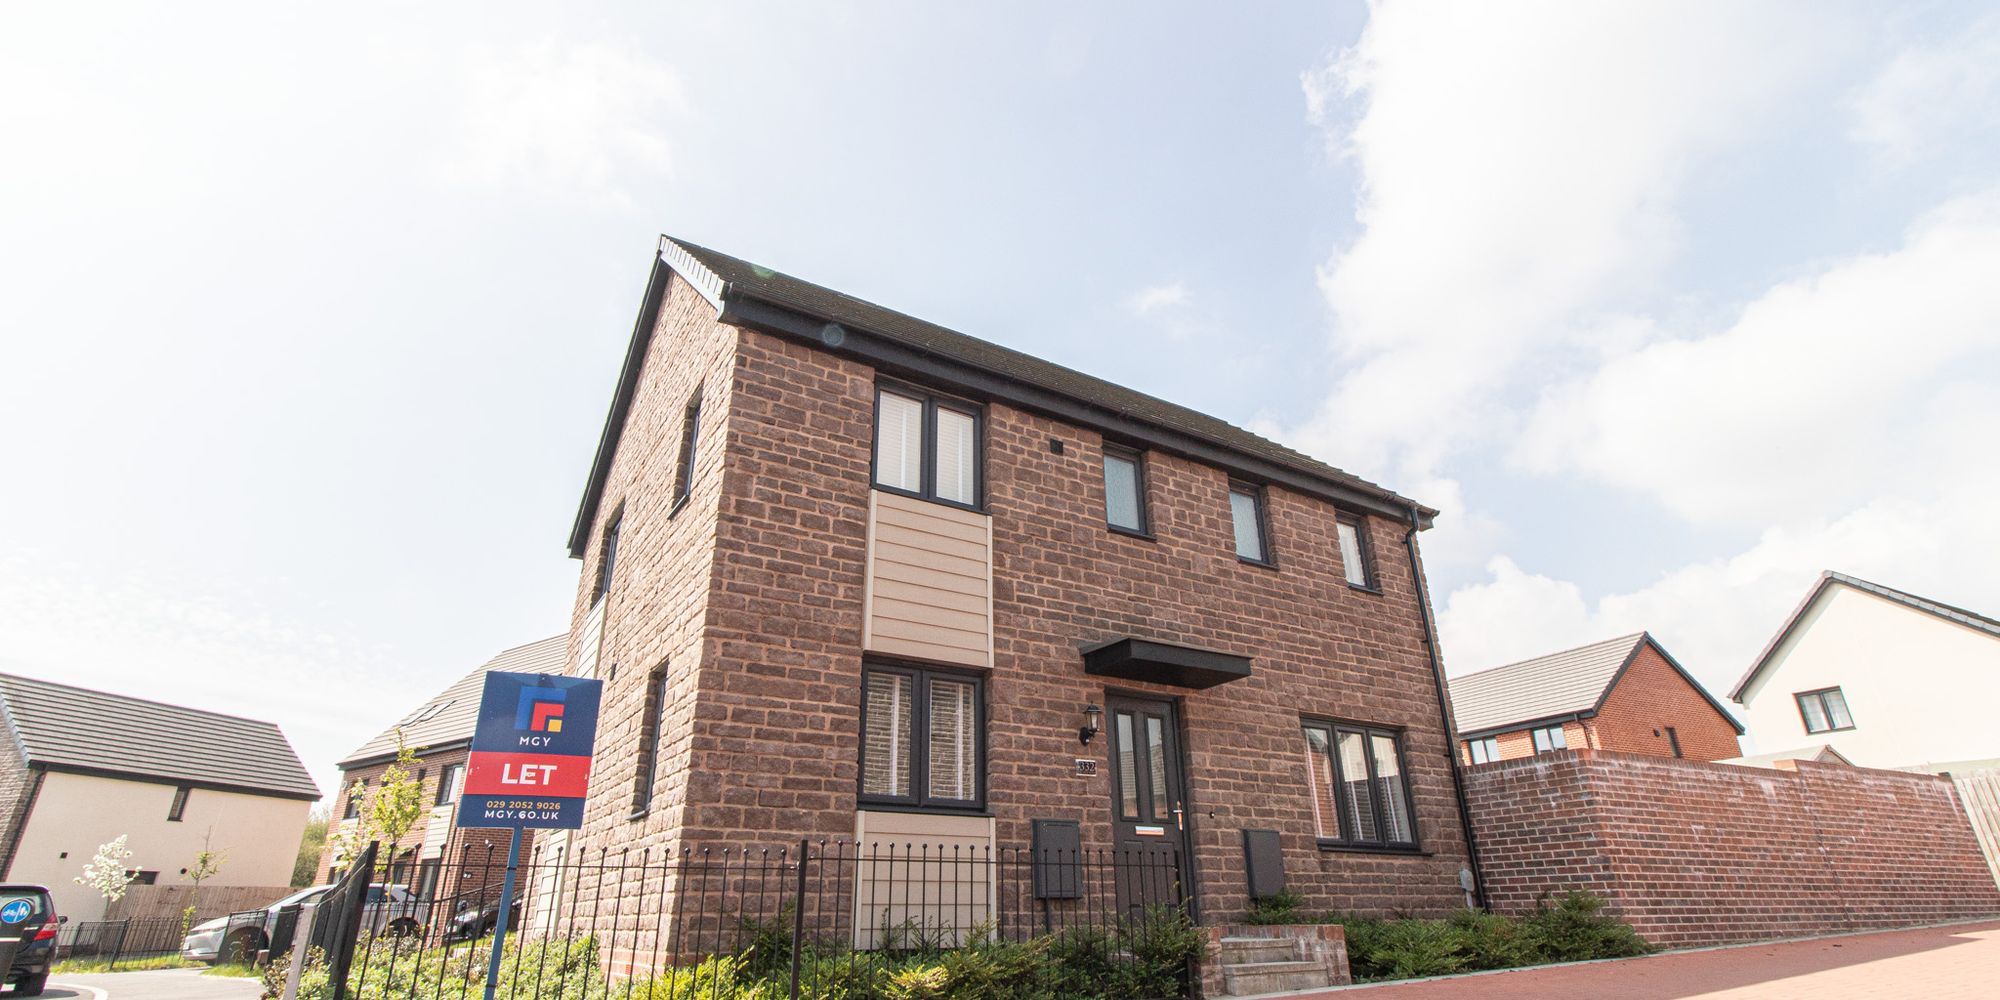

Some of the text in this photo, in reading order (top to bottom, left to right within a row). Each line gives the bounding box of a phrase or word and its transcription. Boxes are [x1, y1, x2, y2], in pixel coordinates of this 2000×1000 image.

[519, 736, 551, 747] MGY
[1079, 762, 1095, 772] 332
[501, 763, 558, 785] LET
[486, 800, 561, 810] 029 2052 9026
